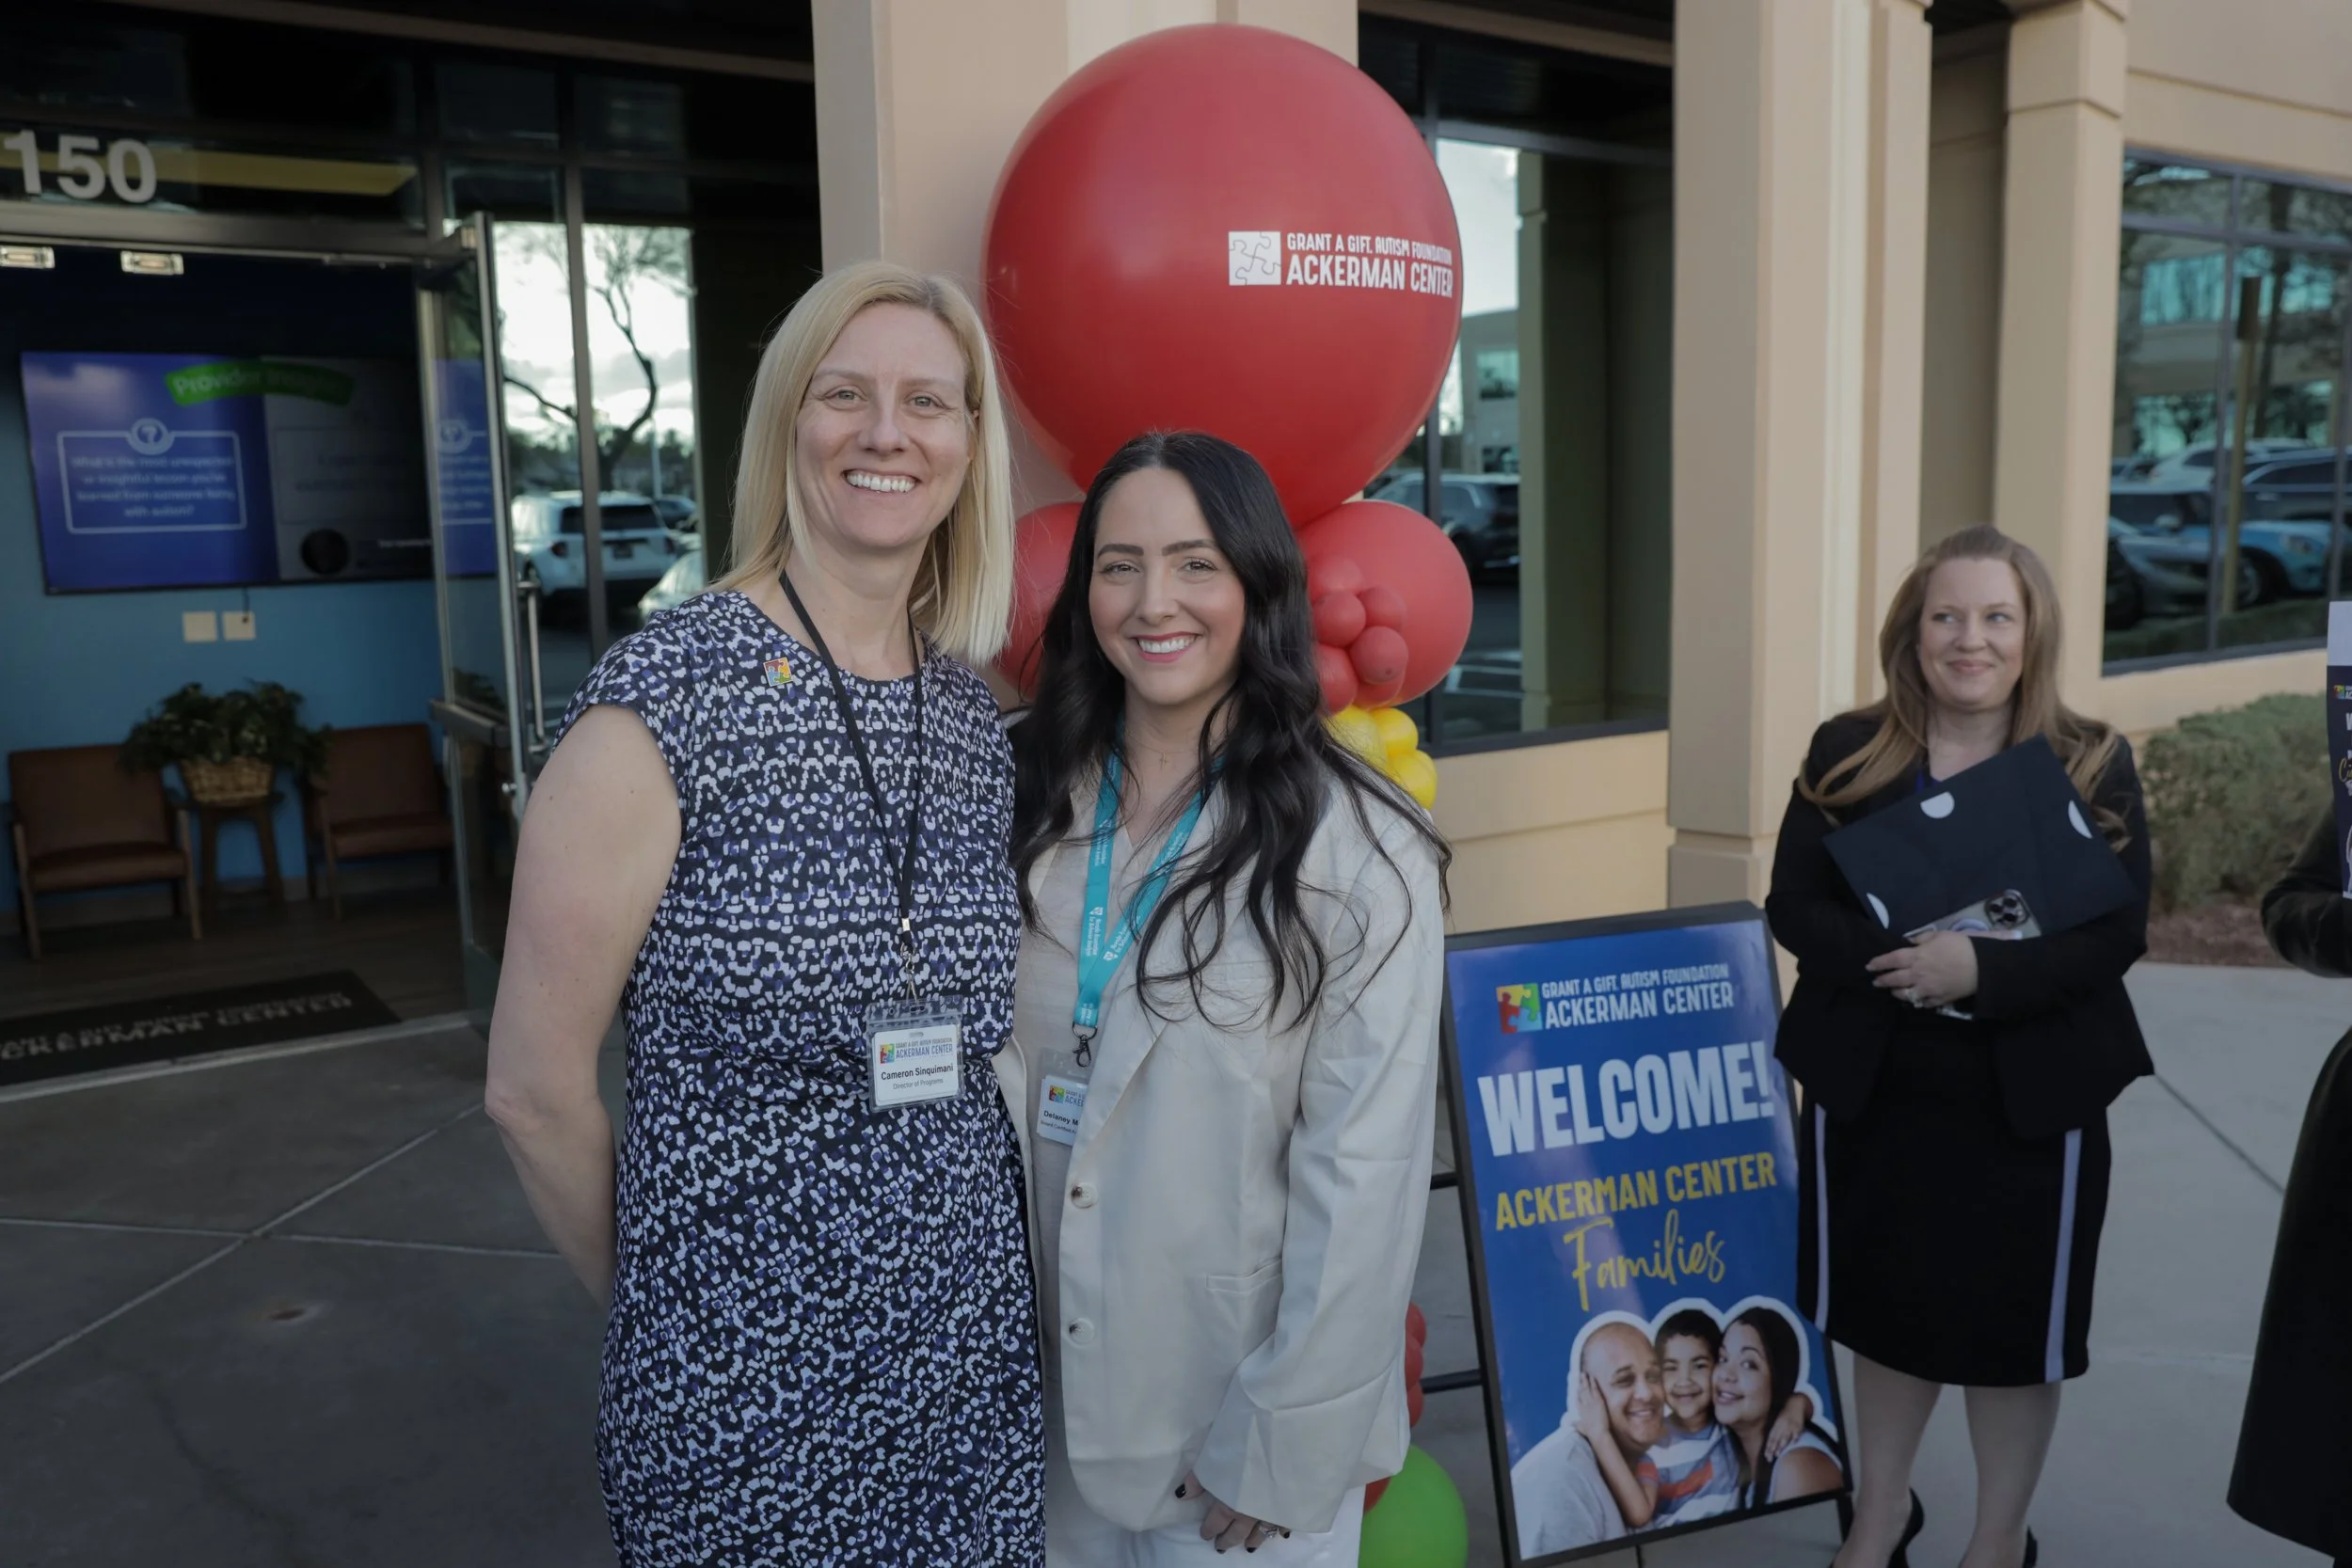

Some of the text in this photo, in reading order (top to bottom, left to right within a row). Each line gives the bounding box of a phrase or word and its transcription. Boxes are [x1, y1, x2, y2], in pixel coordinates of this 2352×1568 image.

[4, 130, 157, 203] 150
[1287, 232, 1332, 252] GRANT
[1335, 234, 1345, 252] A
[1375, 236, 1409, 258] AUTISM
[1411, 241, 1452, 266] FOUNDATION
[1286, 253, 1454, 298] ACKERMAN CENTER
[1542, 979, 1581, 999] GRANT
[1582, 978, 1594, 995] A
[1621, 970, 1661, 990] AUTISM
[1662, 963, 1729, 986] FOUNDATION
[1545, 981, 1735, 1030] ACKERMAN CENTER
[896, 1043, 953, 1059] ACKERMAN CENTER
[881, 1063, 954, 1081] Cameron Sinquimani
[893, 1081, 914, 1090] Director
[920, 1078, 944, 1087] Programs
[1043, 1110, 1071, 1125] Delaney
[1477, 1040, 1775, 1157] WELCOME!
[1496, 1152, 1777, 1231] ACKERMAN CENTER
[1563, 1209, 1725, 1312] Families
